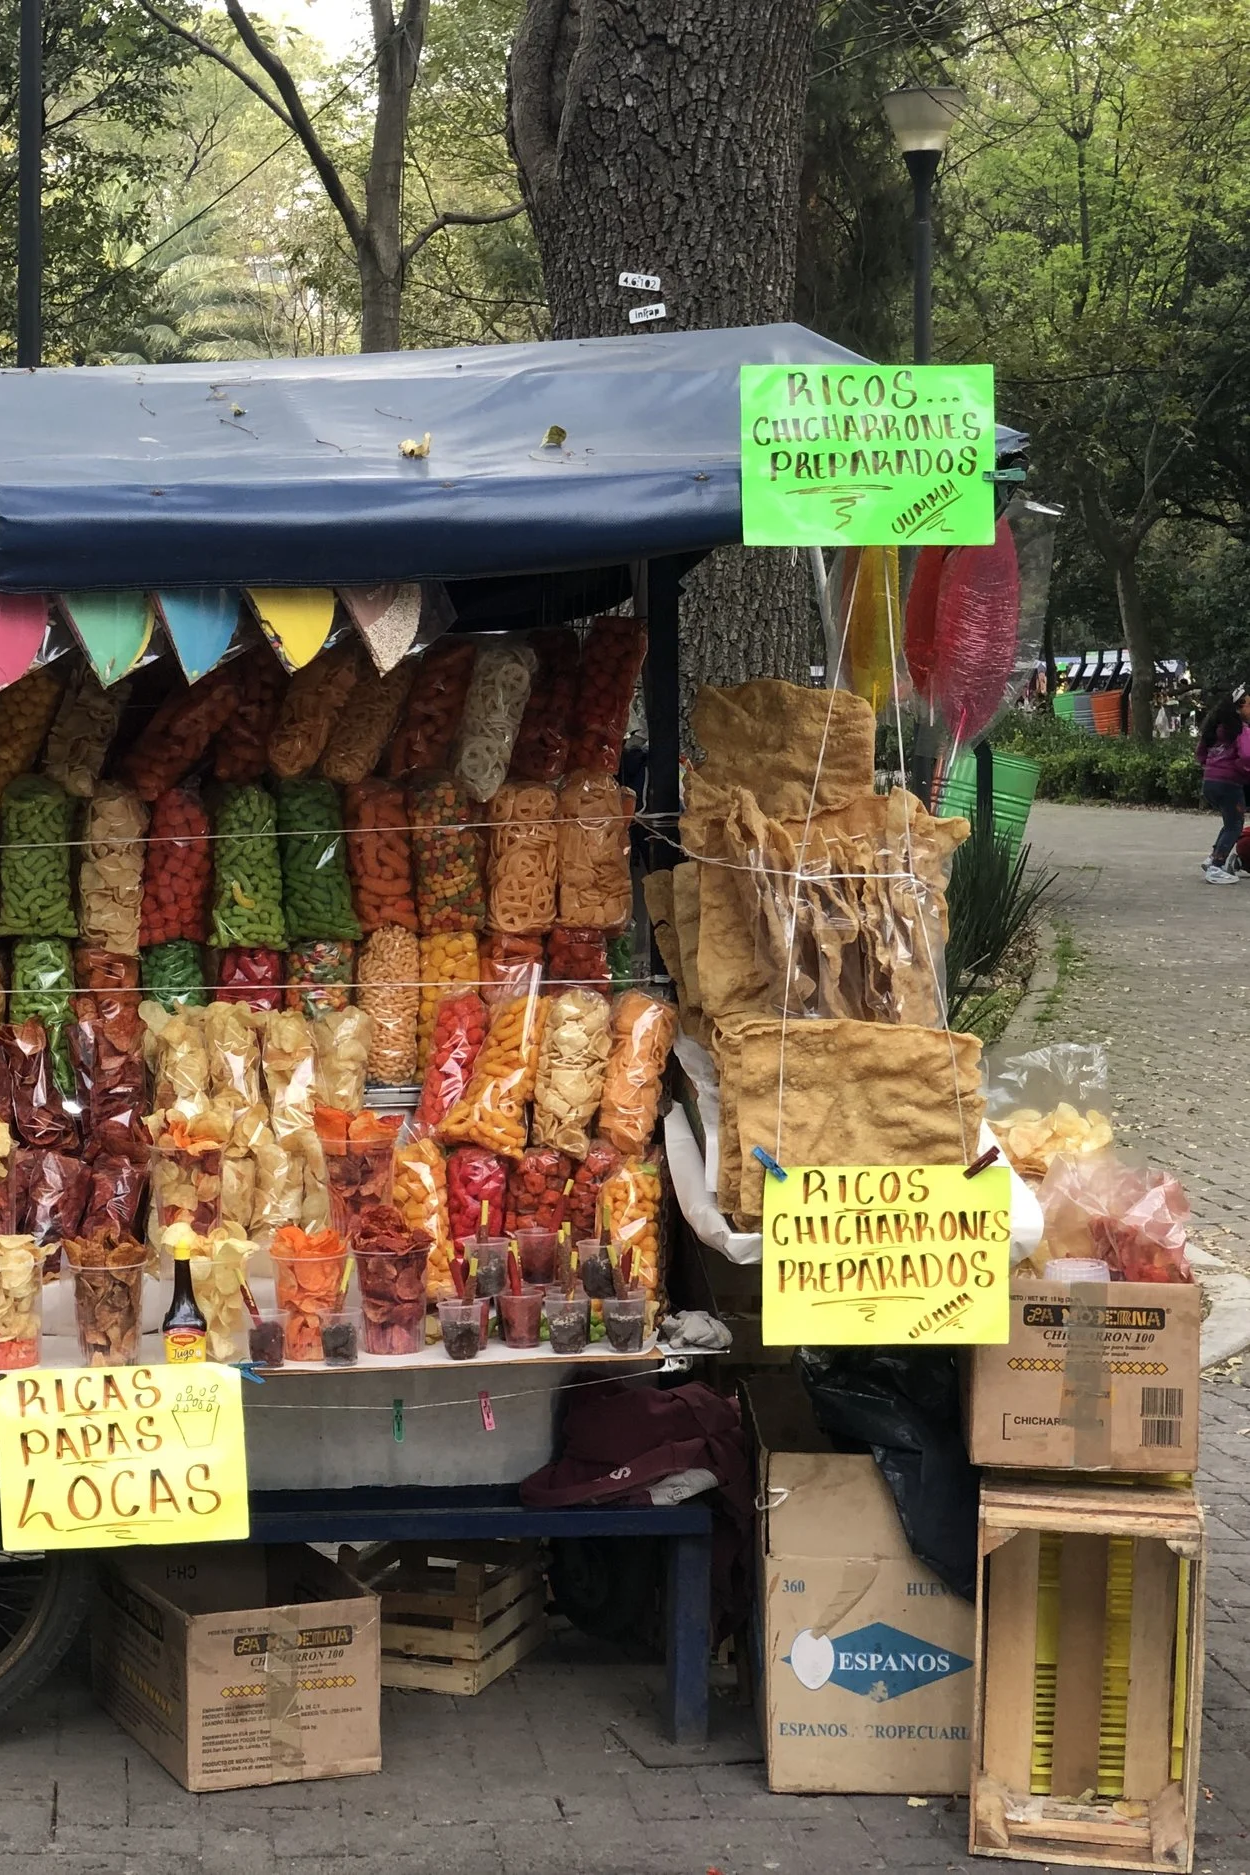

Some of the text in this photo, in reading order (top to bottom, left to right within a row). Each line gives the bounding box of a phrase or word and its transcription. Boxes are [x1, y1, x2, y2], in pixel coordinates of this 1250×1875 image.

[752, 411, 982, 446] CHICHARRONES
[770, 445, 978, 482] PREPARADOS
[802, 1168, 930, 1205] RICOS
[771, 1209, 1011, 1247] CHICHARRONES
[777, 1250, 996, 1294] PREPARADOS
[1134, 1333, 1155, 1343] 100
[17, 1369, 162, 1418] RICAS
[19, 1416, 163, 1466] PAPAS
[17, 1463, 222, 1532] LOCAS
[781, 1579, 806, 1593] 360
[838, 1652, 951, 1673] ESPANOS
[779, 1723, 848, 1737] ESPANOS
